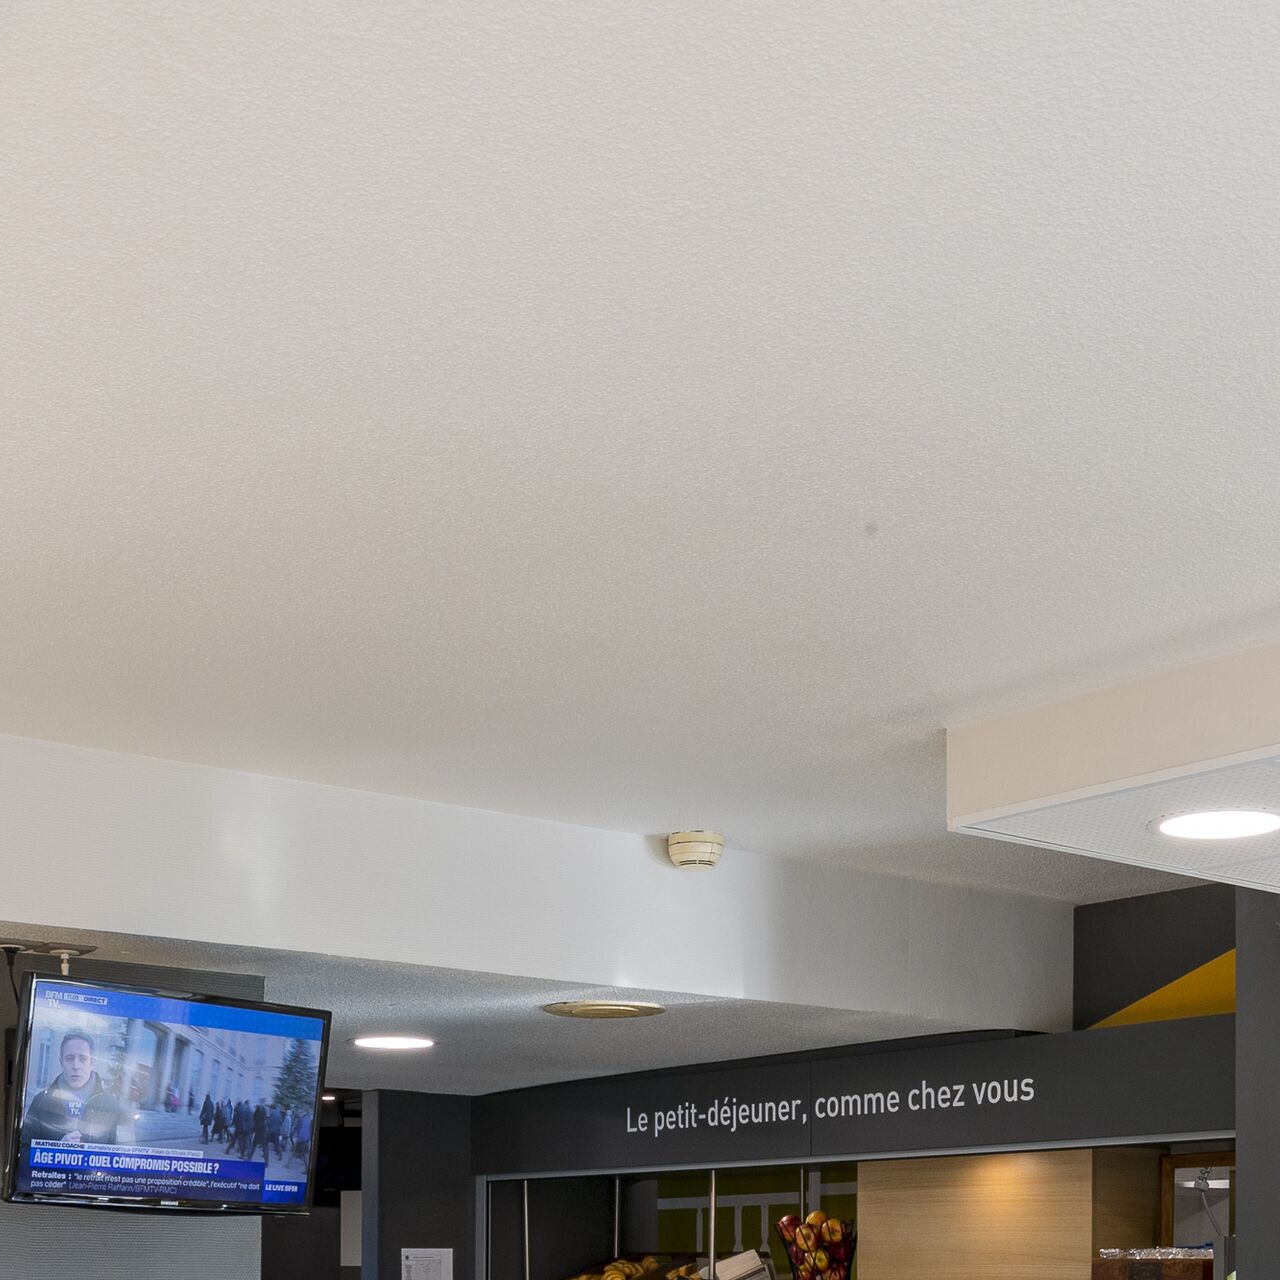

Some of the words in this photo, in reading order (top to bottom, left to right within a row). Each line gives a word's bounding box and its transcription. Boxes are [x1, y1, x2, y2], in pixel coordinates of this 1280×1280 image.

[45, 990, 63, 1000] BFM
[626, 1107, 648, 1132] Le
[654, 1096, 807, 1138] petit-déjeuner,
[815, 1090, 900, 1118] comme
[908, 1080, 966, 1111] chez
[972, 1077, 1035, 1105] vous
[34, 1140, 61, 1148] MATHIEU
[33, 1149, 53, 1164] ÂGE
[55, 1152, 84, 1166] PIVOT
[89, 1155, 111, 1168] QUEL
[112, 1156, 170, 1171] COMPROMIS
[171, 1160, 212, 1174] POSSIBLE
[31, 1170, 66, 1180] Retraites
[83, 1173, 104, 1182] retrait
[121, 1176, 134, 1184] pas
[147, 1176, 182, 1186] proposition
[248, 1182, 260, 1191] doit
